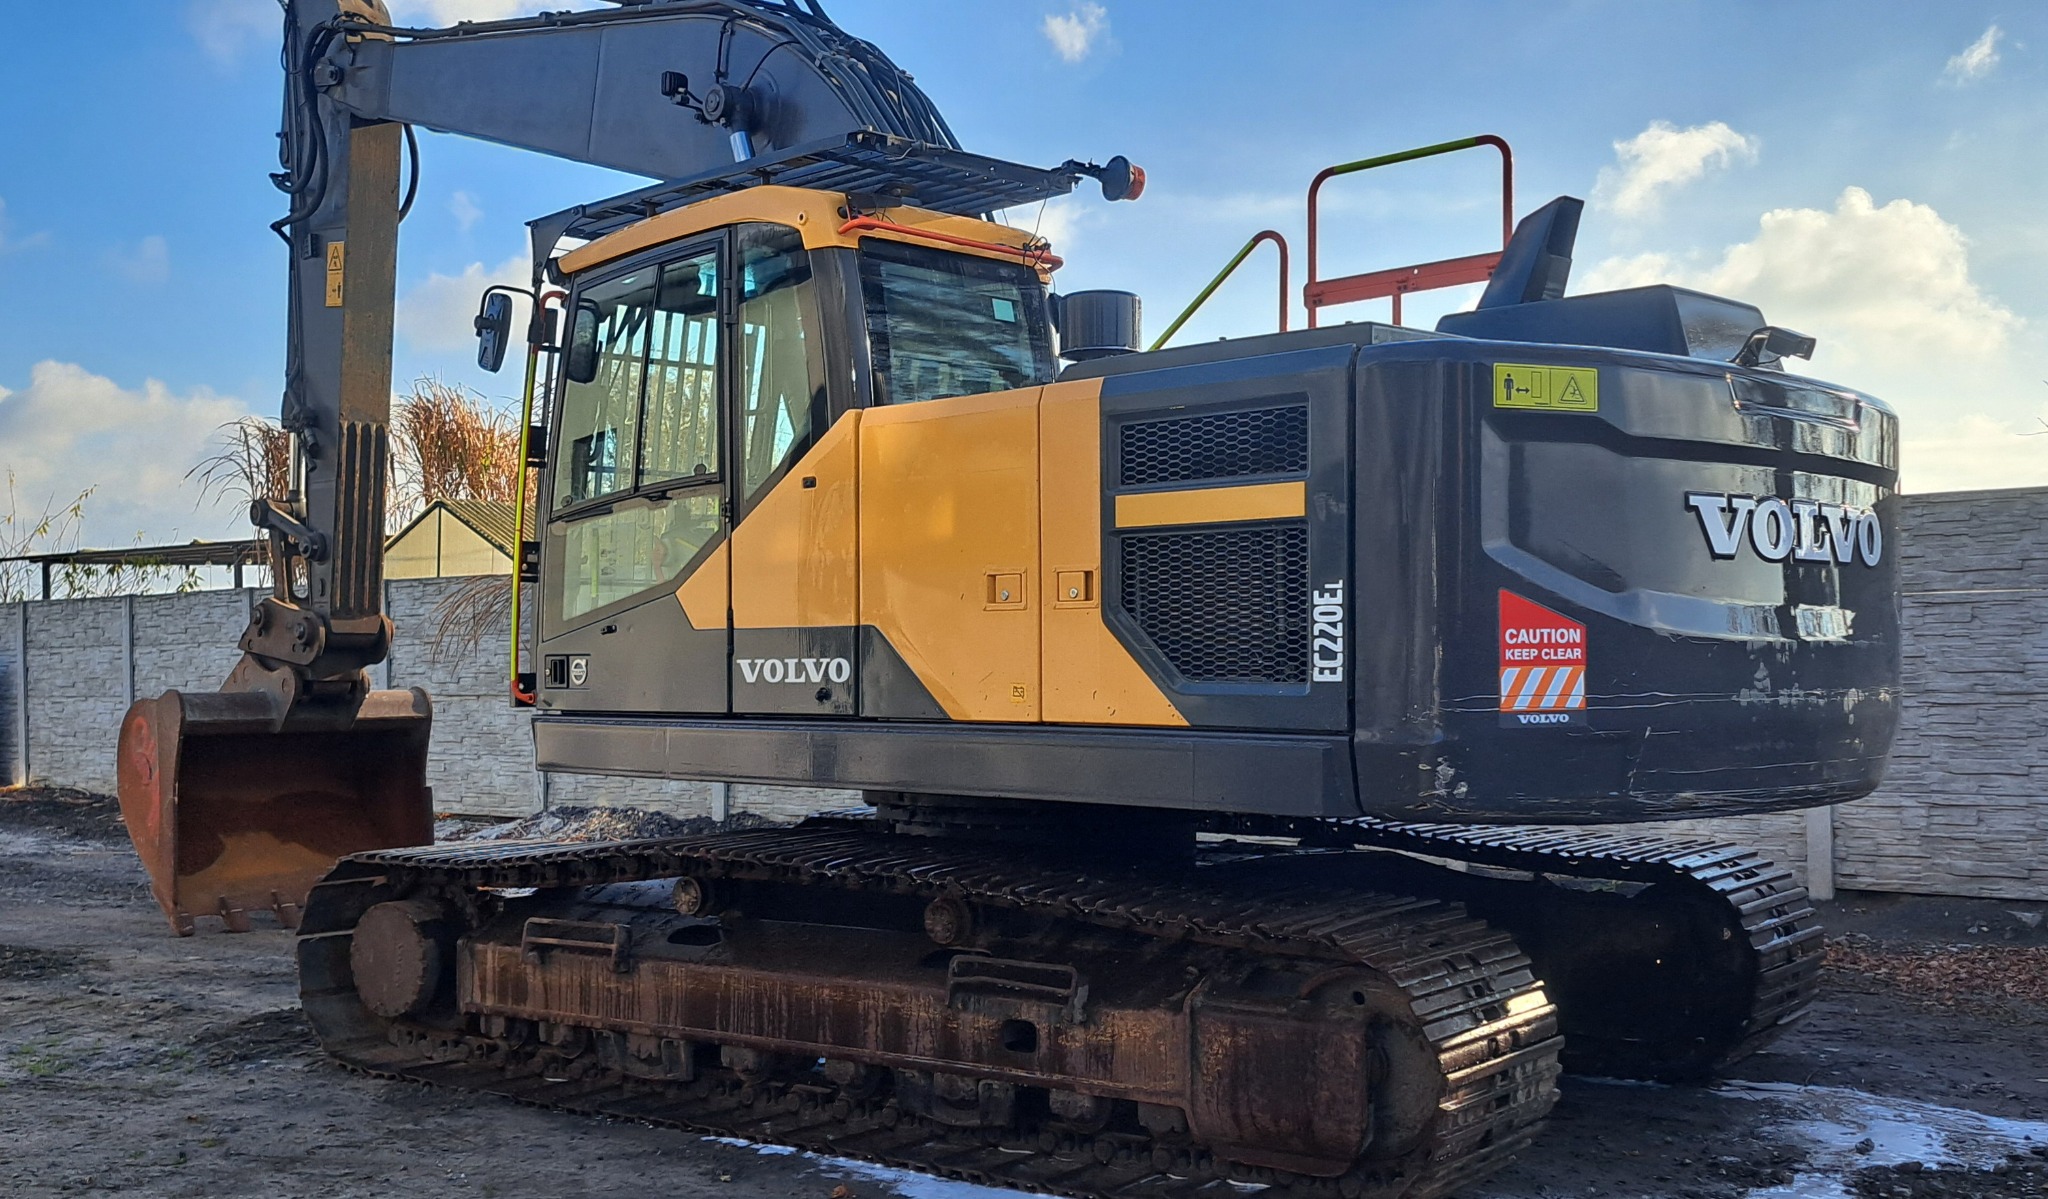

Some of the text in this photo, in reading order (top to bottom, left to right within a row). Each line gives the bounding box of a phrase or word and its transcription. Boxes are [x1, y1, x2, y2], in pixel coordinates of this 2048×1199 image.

[1687, 492, 1882, 567] VOLVO
[1504, 628, 1581, 644] CAUTION
[1505, 648, 1582, 660] KEEP CLEAR
[736, 657, 851, 683] VOLVO
[1517, 713, 1570, 724] VOLVO
